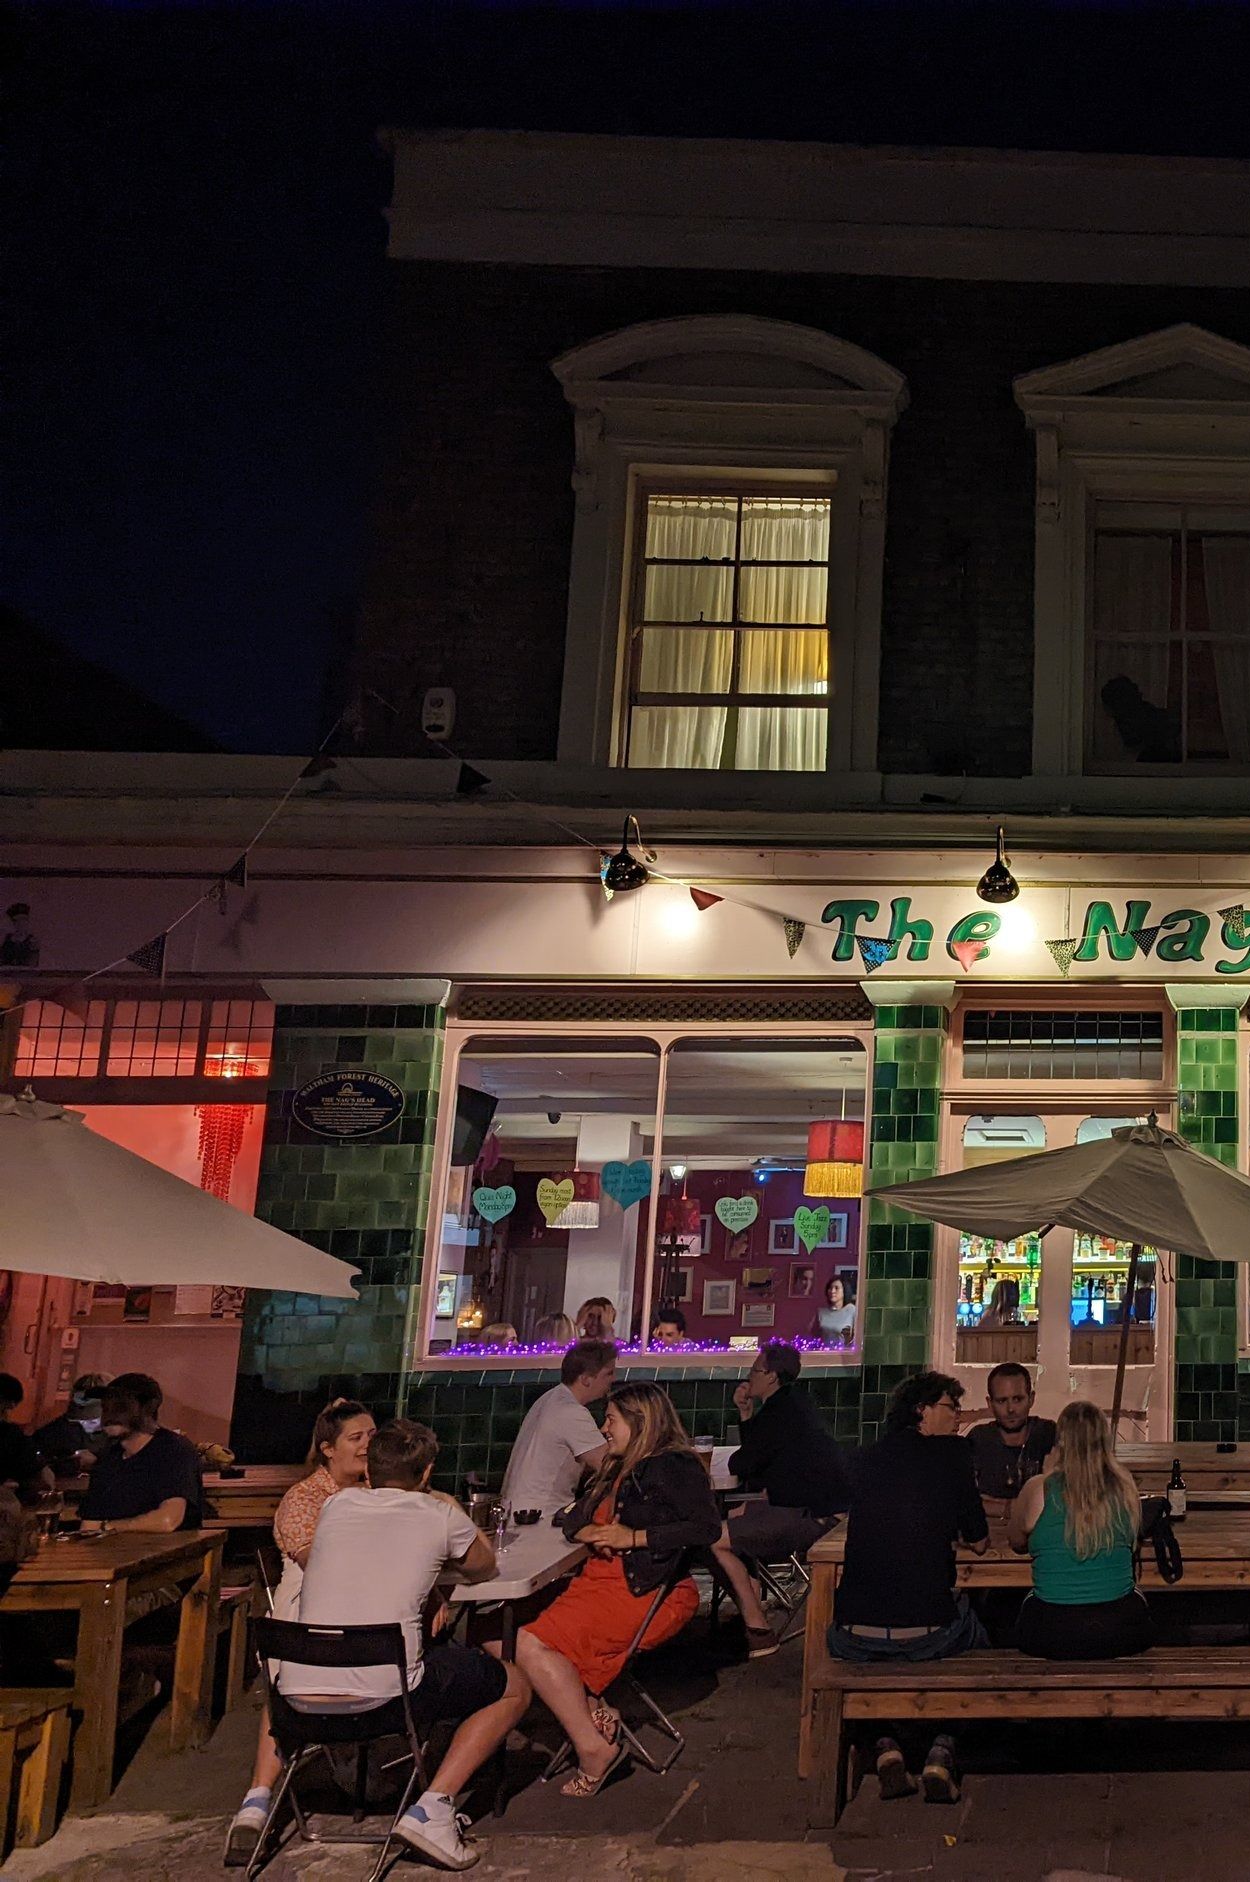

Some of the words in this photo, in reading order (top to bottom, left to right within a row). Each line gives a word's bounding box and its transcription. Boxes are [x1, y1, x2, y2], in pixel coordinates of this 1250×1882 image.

[821, 896, 1001, 962] The
[300, 1075, 335, 1097] WALTHAM
[337, 1072, 366, 1081] FOREST
[368, 1074, 400, 1098] HERITAGE
[800, 1221, 822, 1232] Sunday
